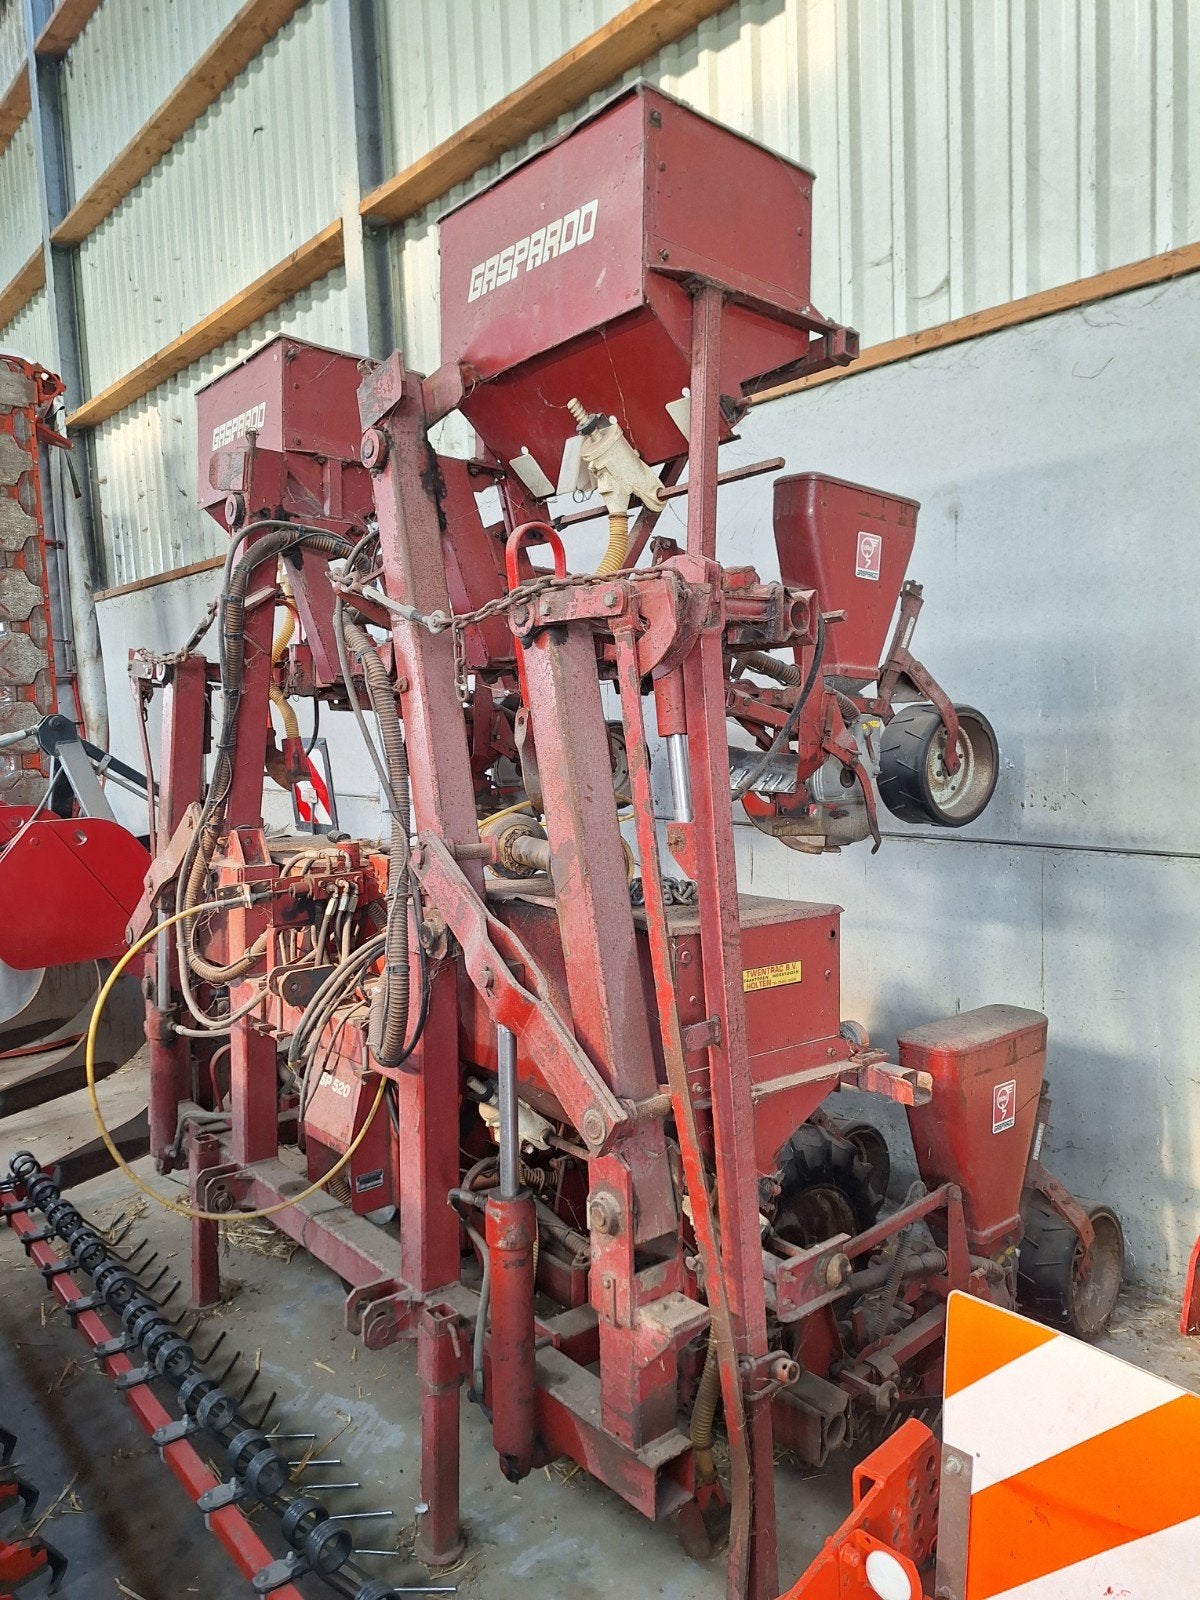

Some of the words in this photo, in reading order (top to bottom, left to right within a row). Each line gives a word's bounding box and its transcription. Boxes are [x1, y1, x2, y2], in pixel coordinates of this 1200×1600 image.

[467, 199, 599, 304] GASPARDO
[211, 401, 266, 452] GASPARDO
[746, 965, 784, 979] TWENTRAC
[746, 979, 772, 990] HOLTEN
[331, 1078, 351, 1098] 520
